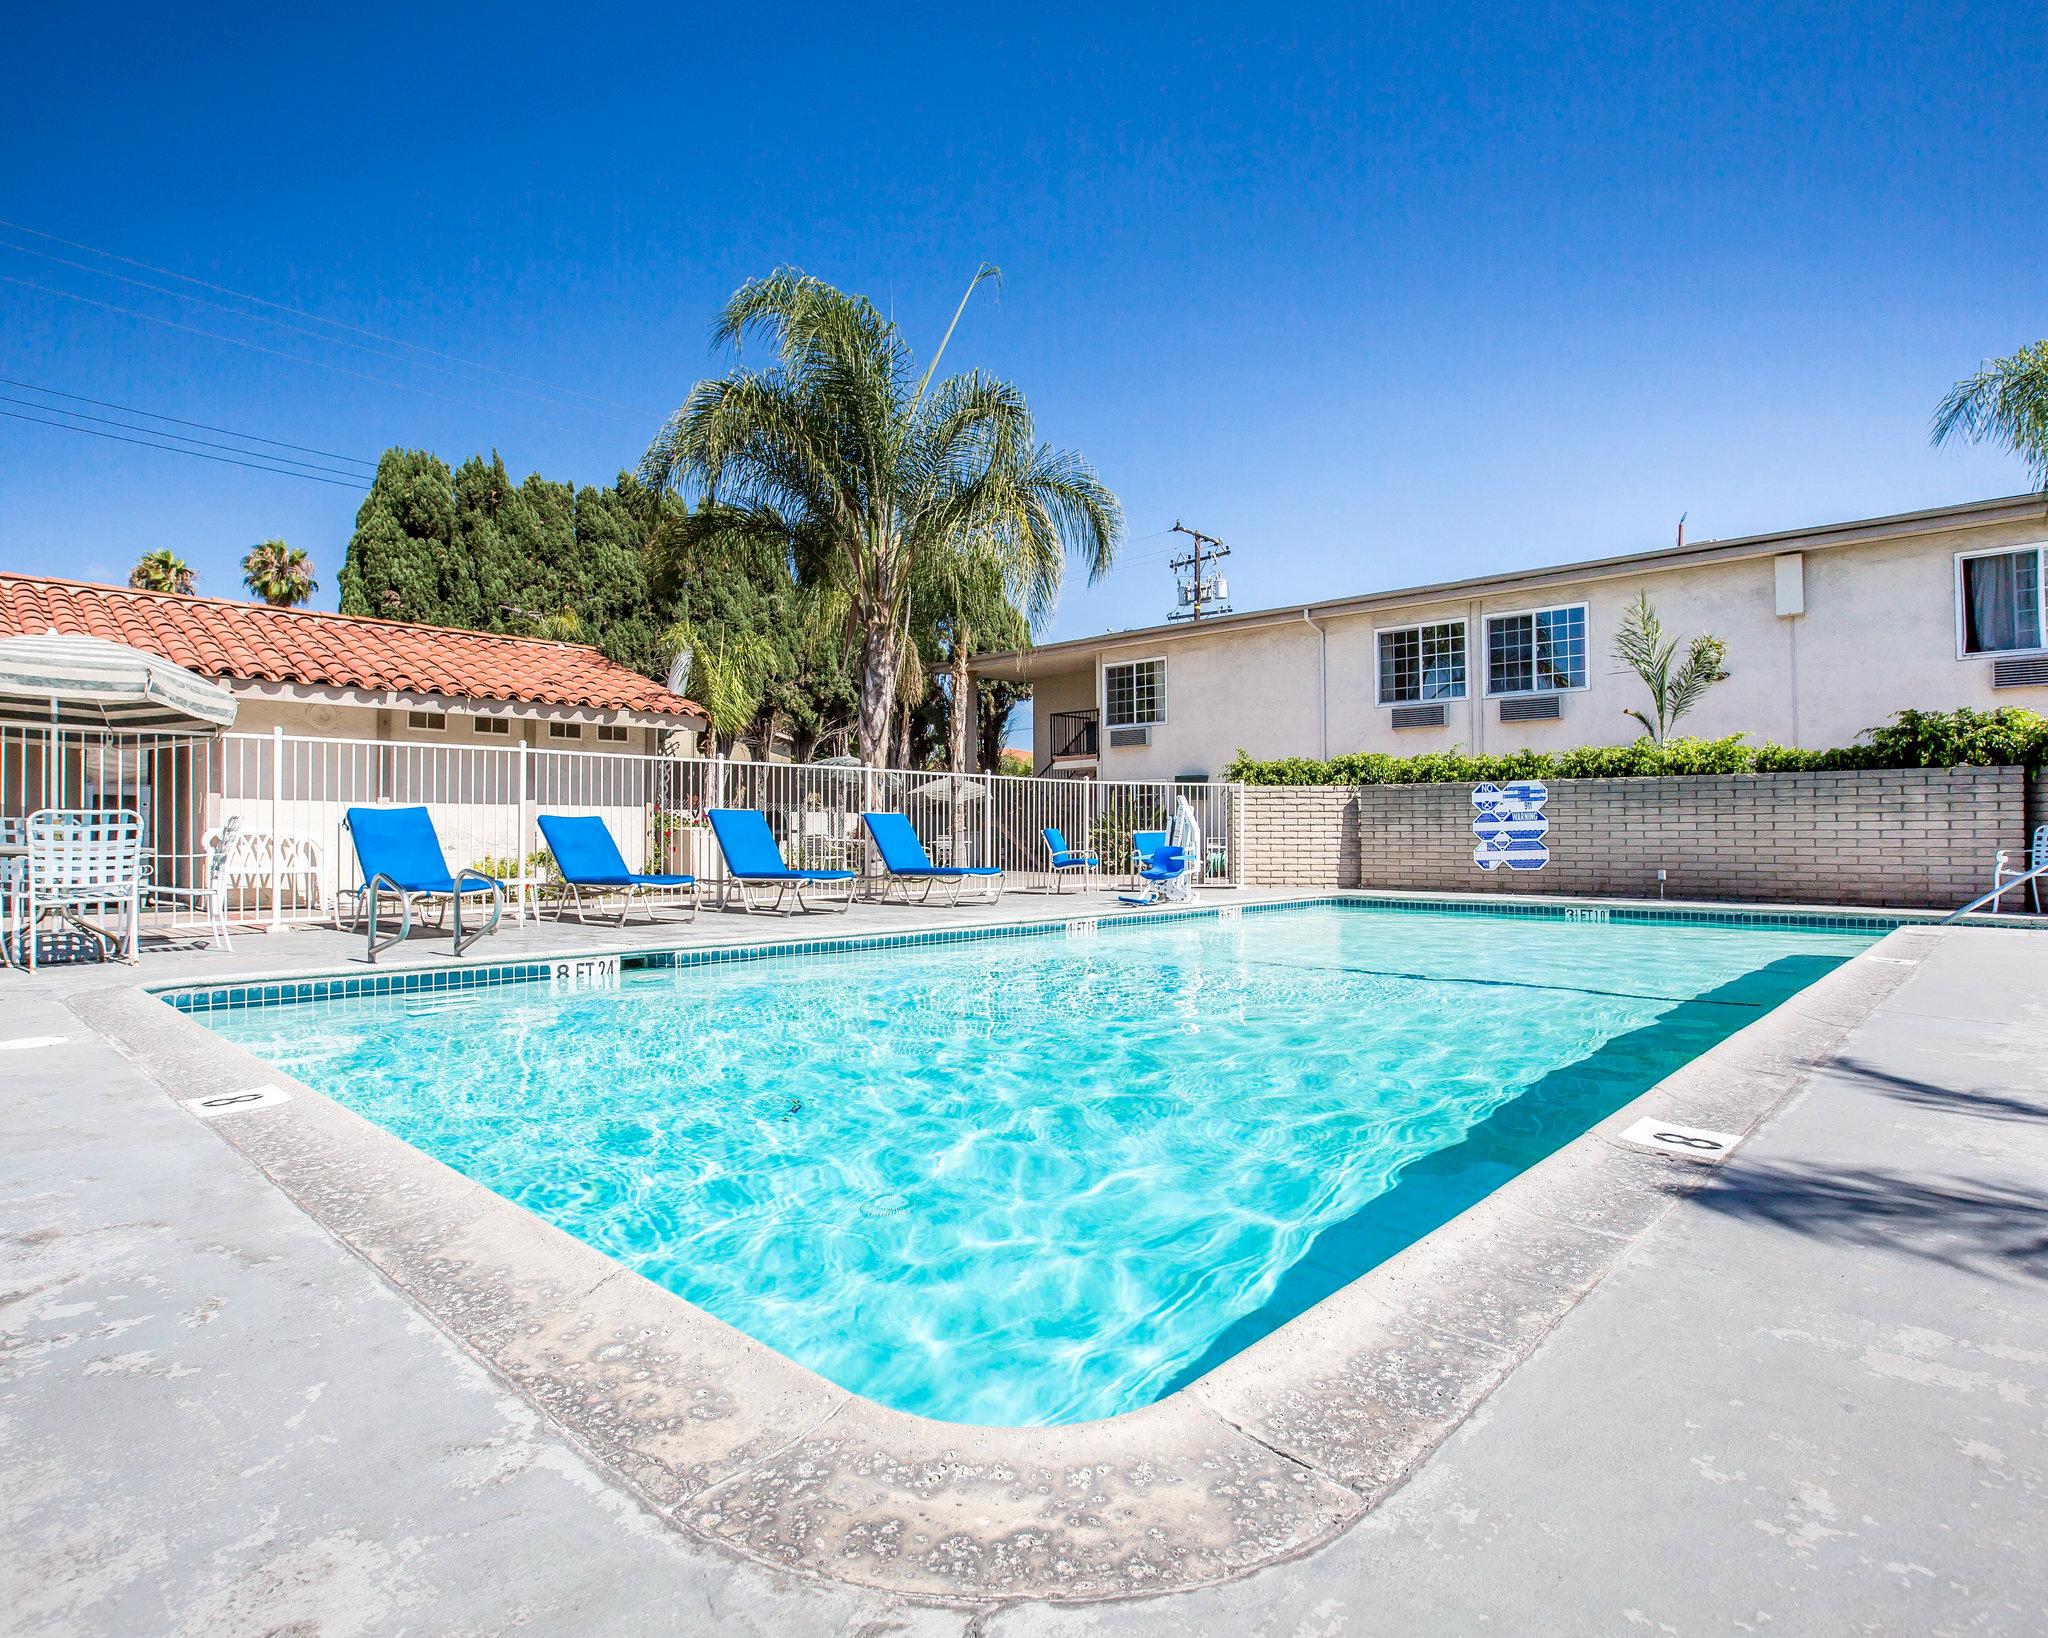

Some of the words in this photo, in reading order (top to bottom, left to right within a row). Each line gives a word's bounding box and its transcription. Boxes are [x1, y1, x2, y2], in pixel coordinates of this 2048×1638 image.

[1481, 784, 1493, 792] NO
[1511, 811, 1538, 821] WARNING
[1580, 909, 1594, 919] FT
[1077, 922, 1086, 931] FT
[556, 964, 570, 978] 8
[576, 962, 595, 977] FT
[1653, 1132, 1724, 1150] 8
